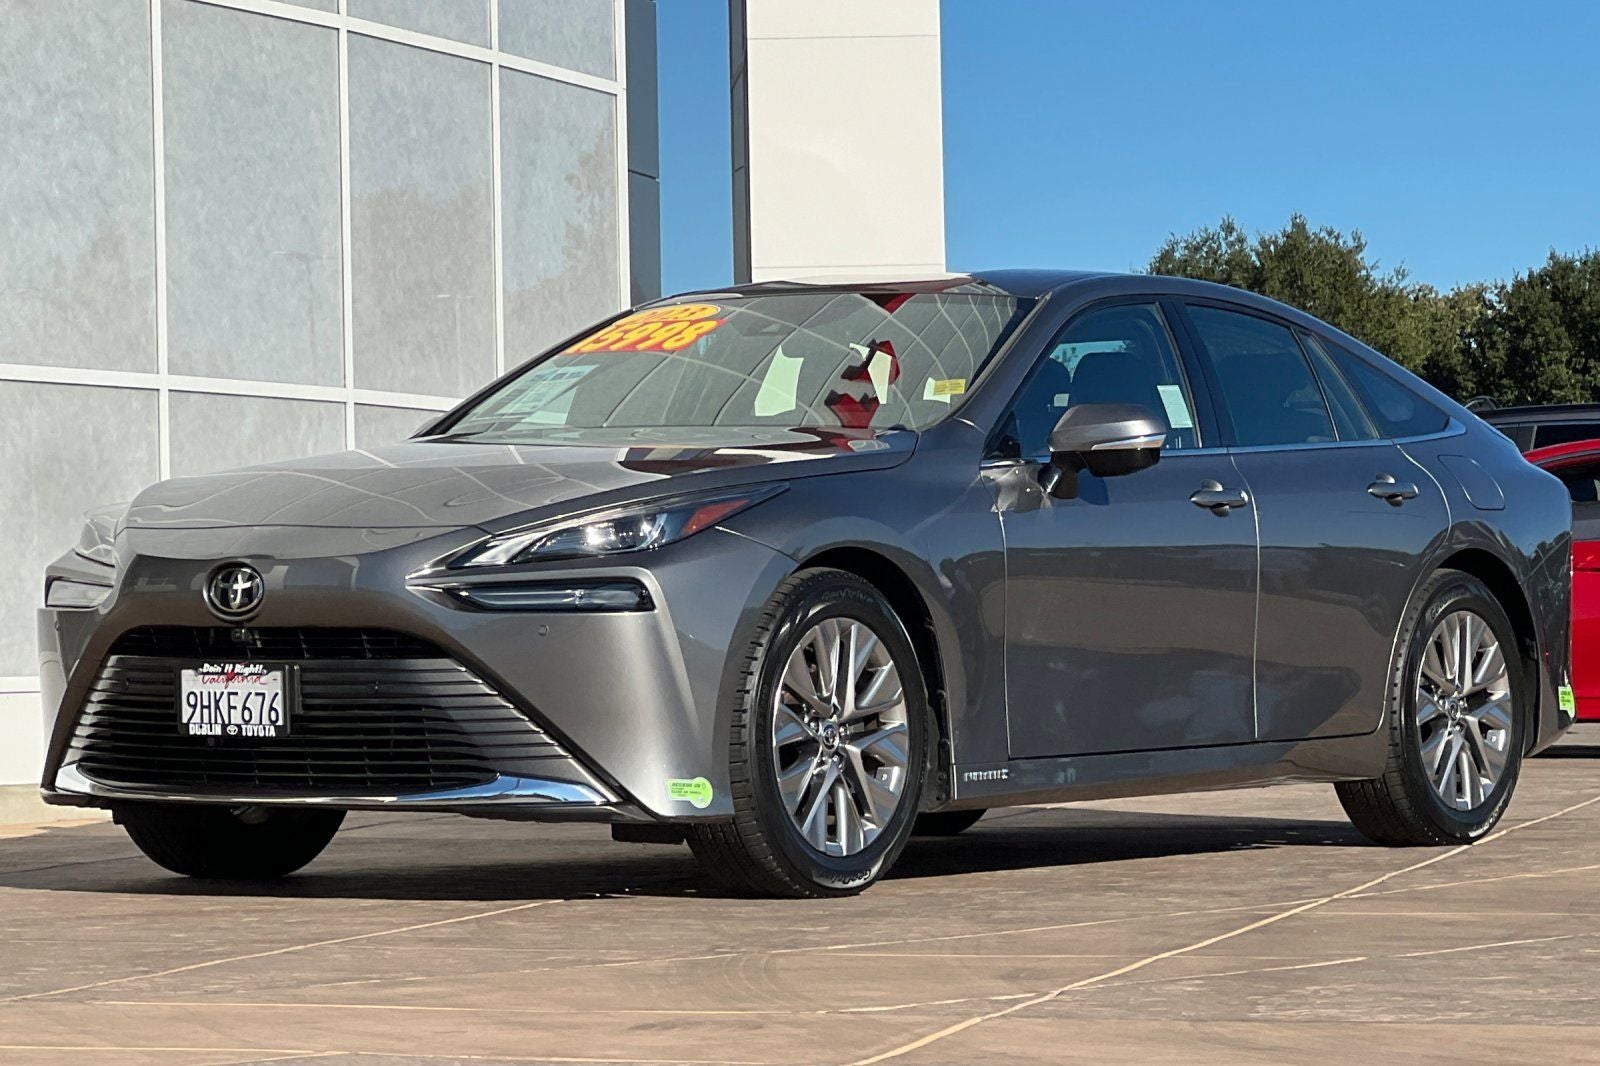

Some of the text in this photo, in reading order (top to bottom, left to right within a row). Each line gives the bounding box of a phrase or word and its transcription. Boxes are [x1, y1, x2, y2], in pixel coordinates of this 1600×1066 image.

[202, 663, 224, 673] Doin'
[186, 690, 279, 725] 9HKF676
[188, 723, 276, 737] DUBLIN TOYOTA
